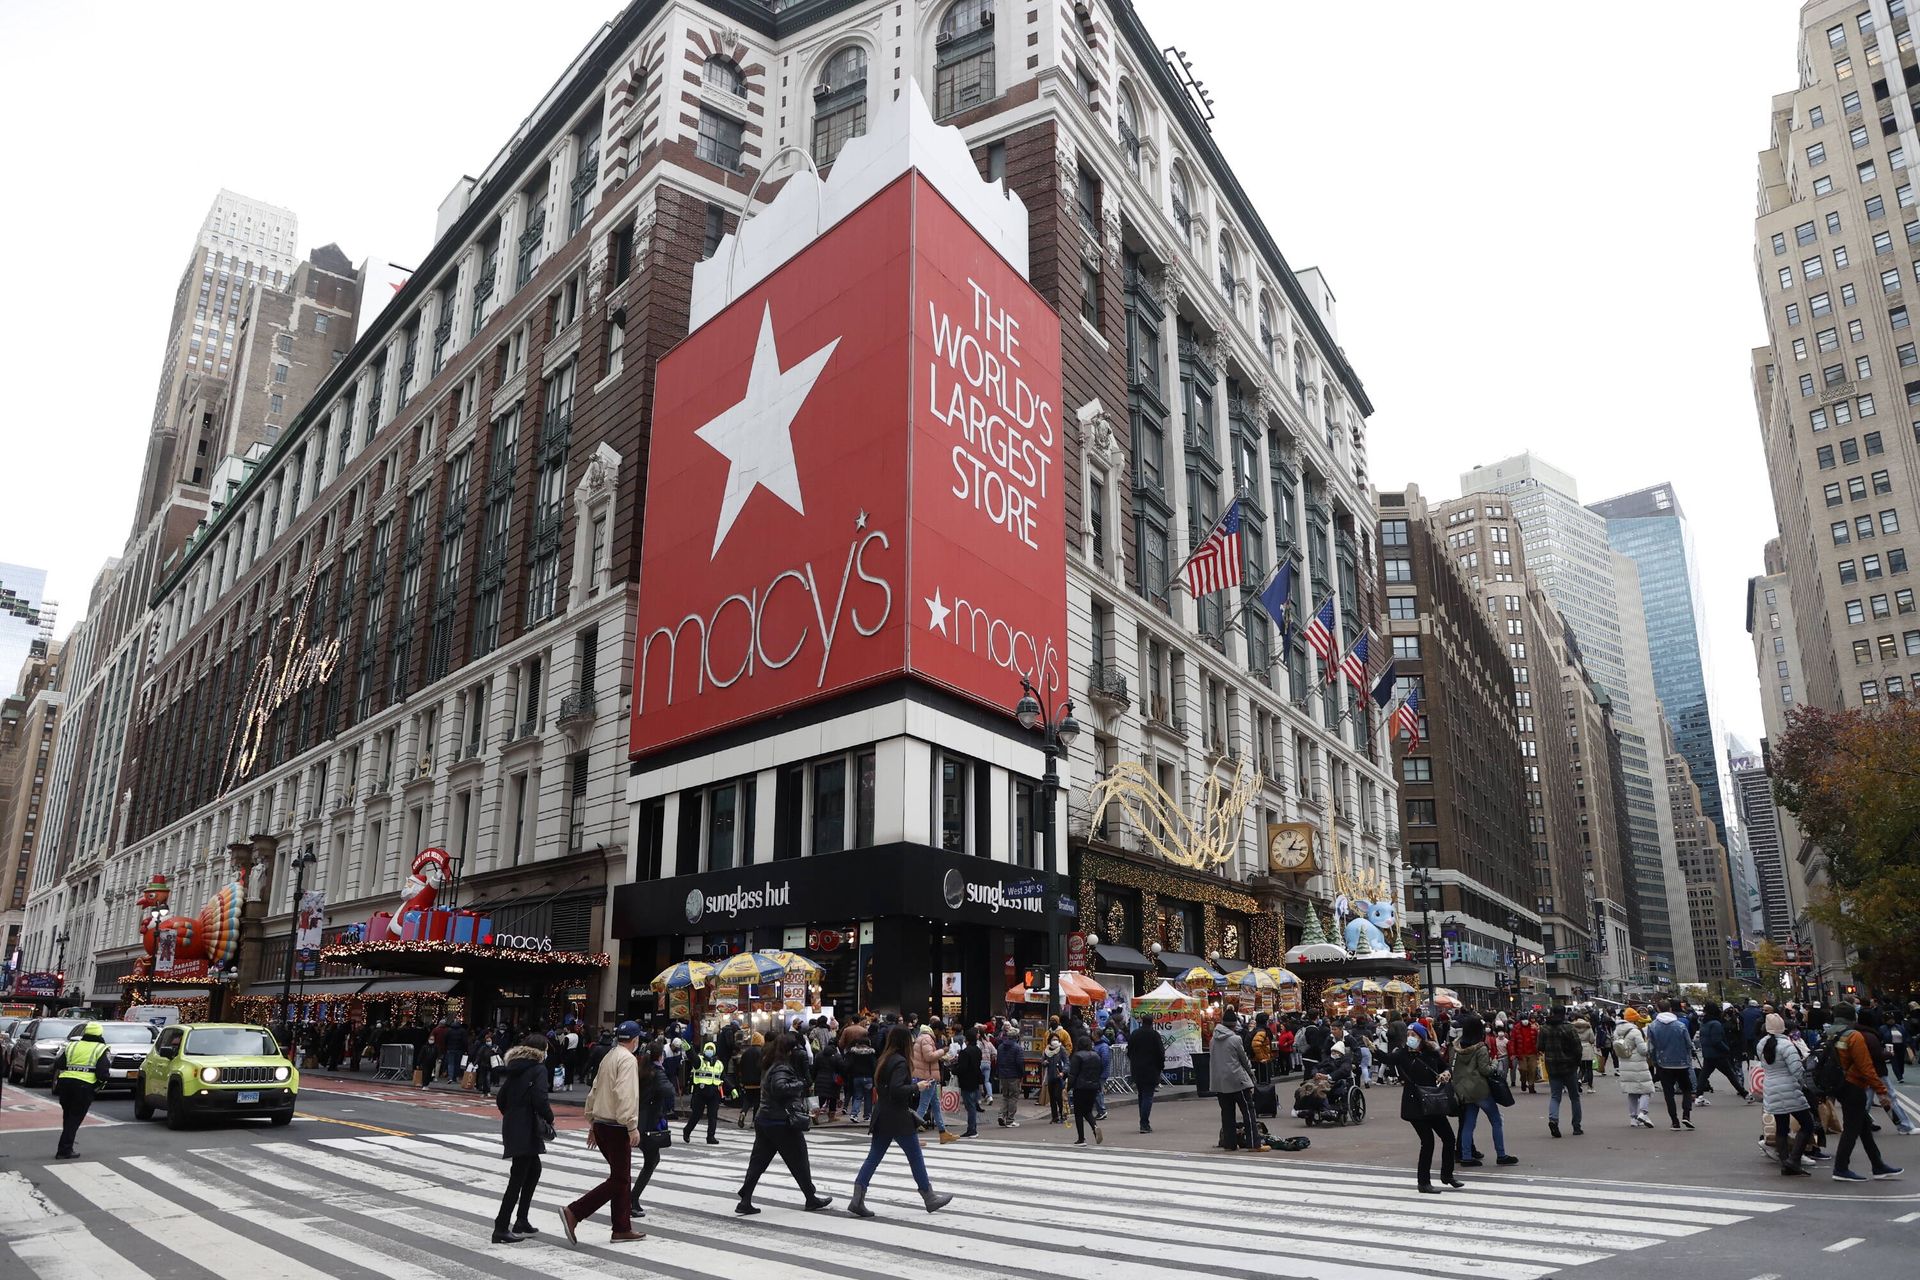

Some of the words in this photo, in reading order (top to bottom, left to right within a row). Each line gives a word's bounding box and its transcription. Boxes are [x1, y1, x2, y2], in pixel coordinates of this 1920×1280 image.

[967, 277, 1021, 368] THE
[929, 300, 1053, 448] WORLD'S
[929, 362, 1052, 499] LARGEST
[951, 445, 1039, 551] STORE
[705, 885, 763, 918] sunglass
[765, 880, 790, 907] hut
[1007, 886, 1023, 896] West
[1023, 884, 1036, 894] 34th
[1036, 884, 1043, 893] St
[1058, 900, 1075, 913] Broadway
[495, 933, 552, 953] macy's
[174, 960, 200, 970] PARADES
[1068, 959, 1085, 967] OPEN
[1069, 953, 1084, 961] NOW
